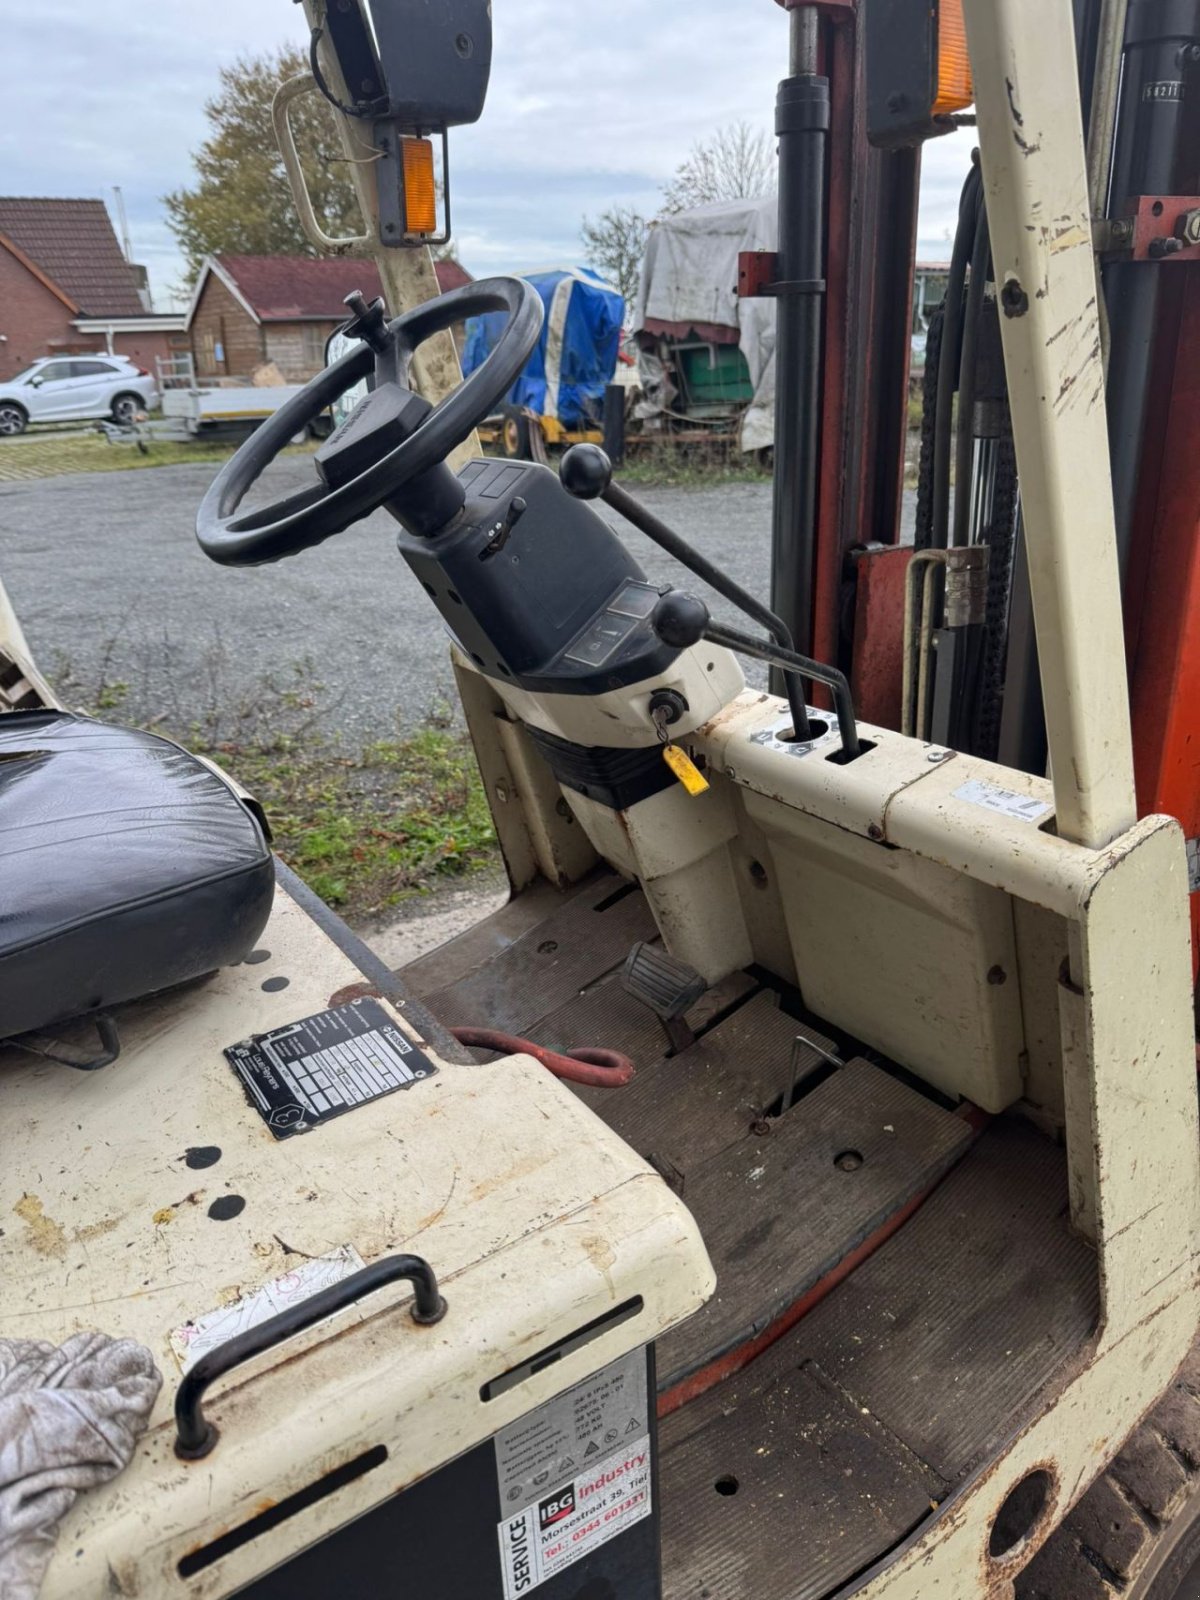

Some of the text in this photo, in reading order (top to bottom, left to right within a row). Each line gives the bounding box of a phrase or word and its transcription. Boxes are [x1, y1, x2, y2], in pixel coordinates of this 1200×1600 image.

[389, 1032, 411, 1053] NISSAN
[586, 1402, 607, 1418] VOLT
[541, 1493, 573, 1521] IBG
[578, 1453, 646, 1499] Industry
[541, 1500, 607, 1544] Morsestraat
[609, 1489, 625, 1503] 39,
[630, 1472, 648, 1489] Tiel
[509, 1515, 531, 1592] SERVICE
[544, 1541, 569, 1558] Tel.:
[571, 1522, 601, 1541] 0344
[604, 1492, 645, 1521] 601331
